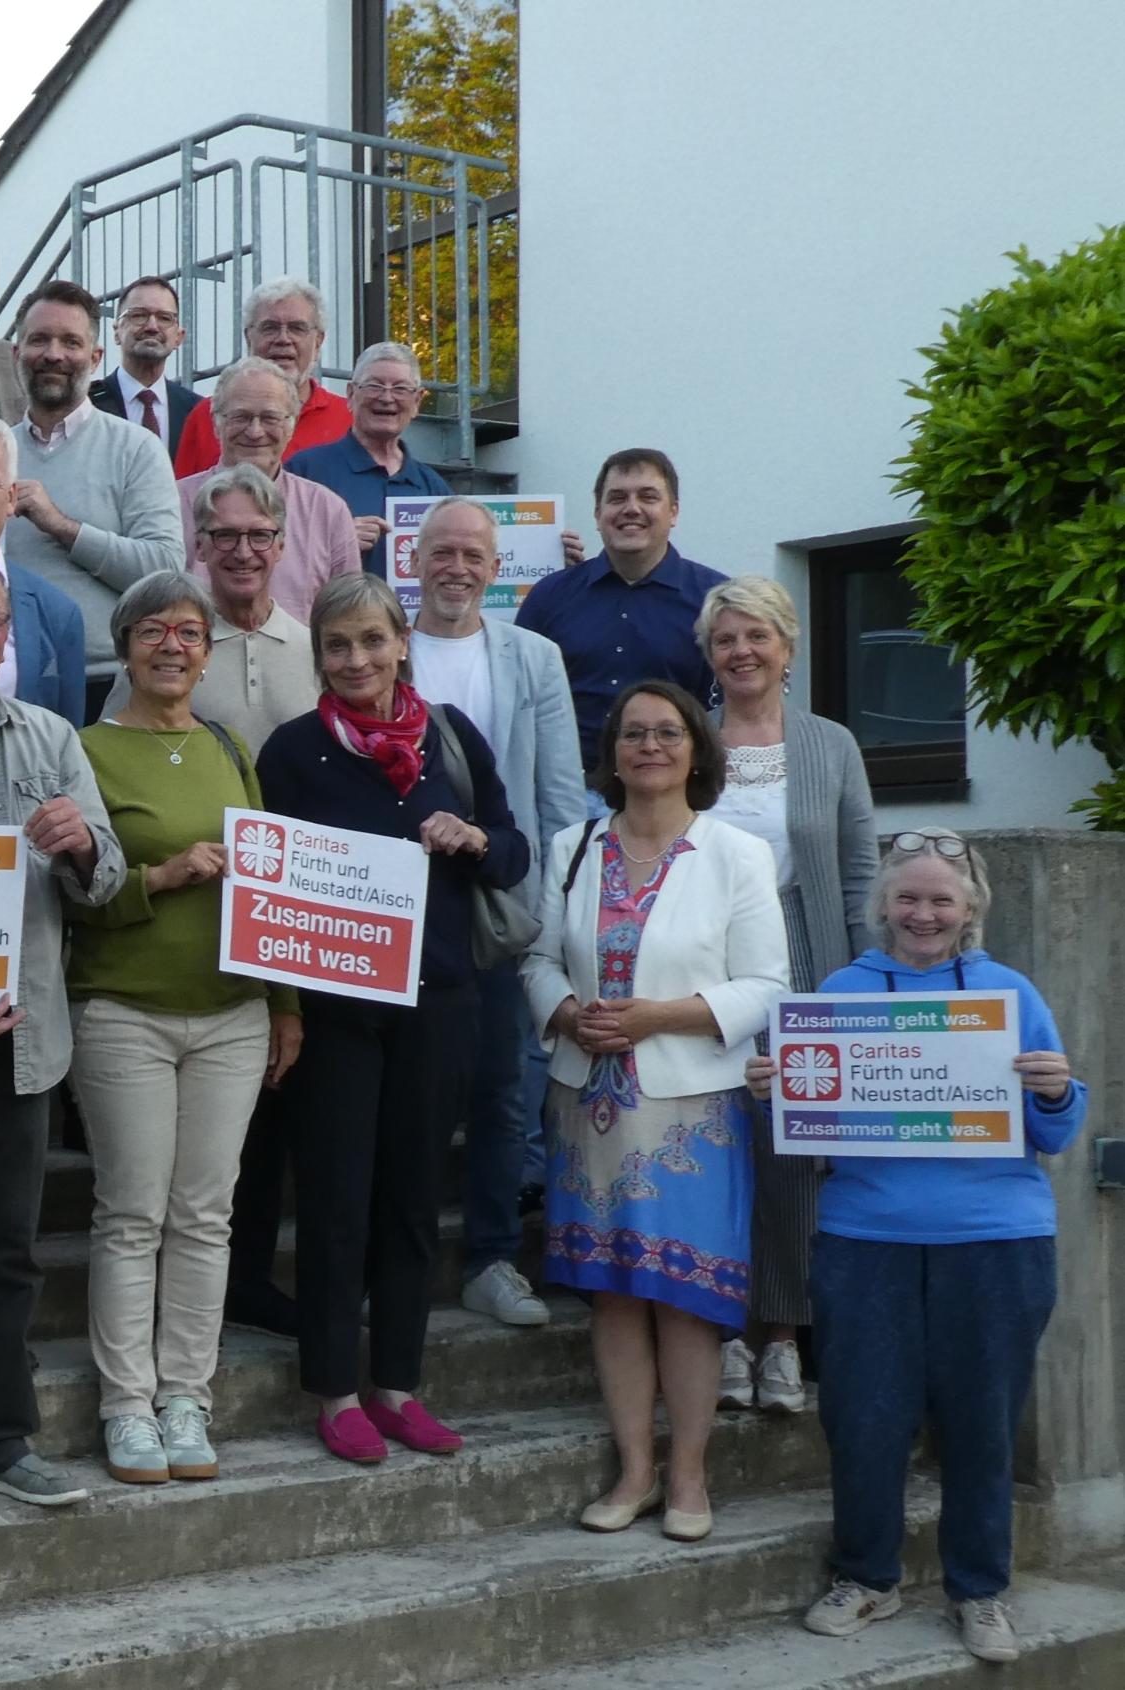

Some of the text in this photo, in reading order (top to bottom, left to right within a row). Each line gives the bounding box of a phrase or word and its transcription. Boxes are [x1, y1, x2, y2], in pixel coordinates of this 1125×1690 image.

[512, 511, 542, 521] was.
[292, 829, 349, 855] Caritas
[291, 851, 369, 880] Fürth und
[289, 873, 414, 910] Neustadt/Aisch
[251, 894, 392, 945] Zusammen
[258, 936, 377, 977] geht was.
[786, 1011, 987, 1030] Zusammen geht was.
[849, 1043, 922, 1059] Caritas
[851, 1065, 948, 1081] Fürth und
[851, 1086, 1008, 1102] Neustadt/Aisch
[790, 1121, 991, 1139] Zusammen geht was.
